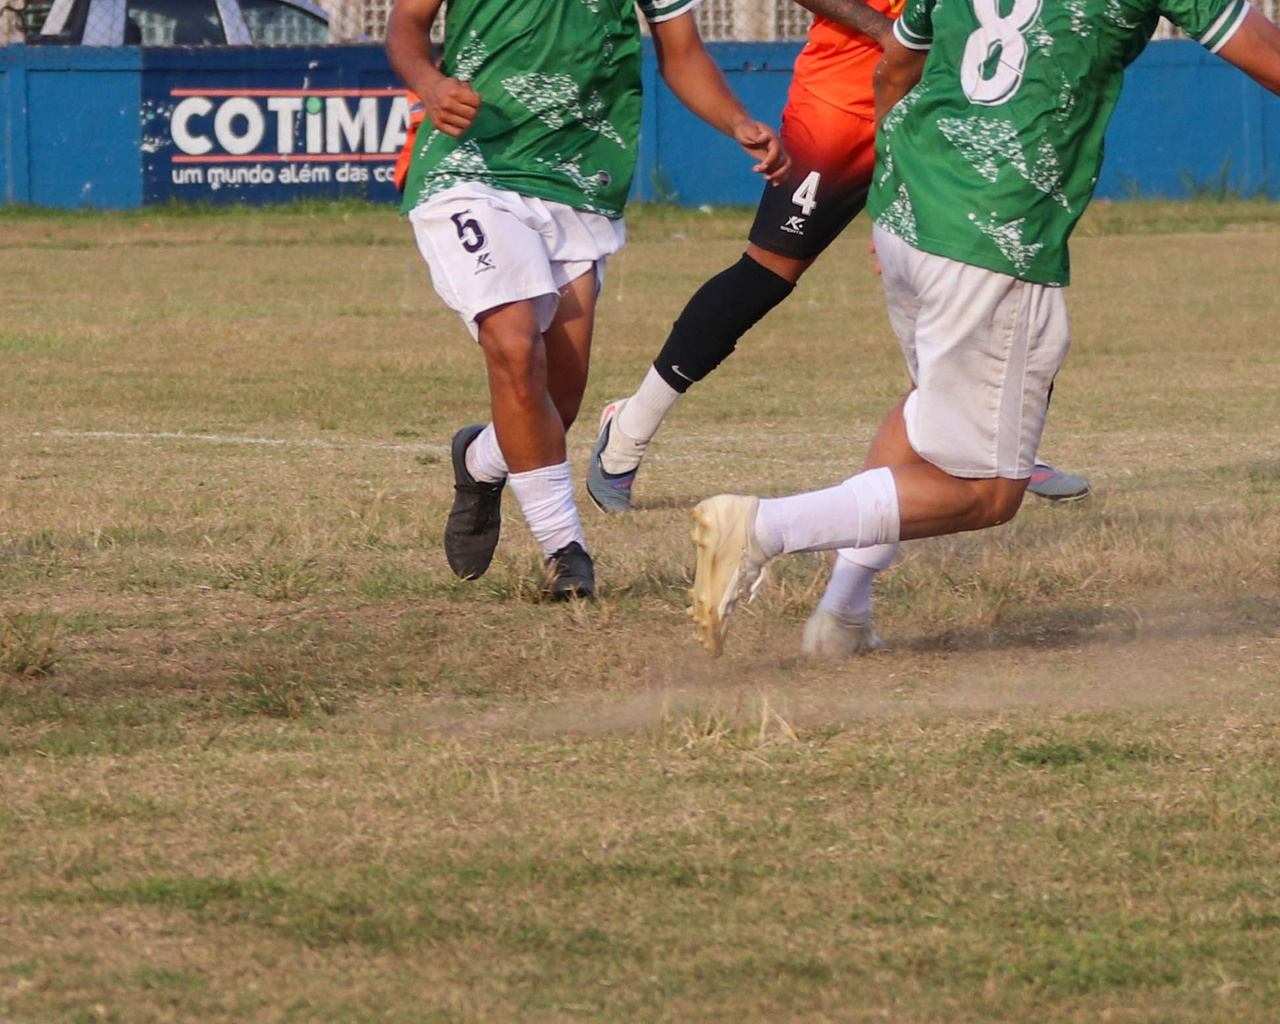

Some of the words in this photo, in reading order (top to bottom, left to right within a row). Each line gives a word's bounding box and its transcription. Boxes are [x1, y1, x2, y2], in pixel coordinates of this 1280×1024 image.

[172, 169, 201, 184] um
[207, 164, 274, 184] mundo
[278, 164, 330, 183] além
[335, 163, 368, 183] das
[792, 171, 821, 216] 4
[450, 209, 488, 253] 5
